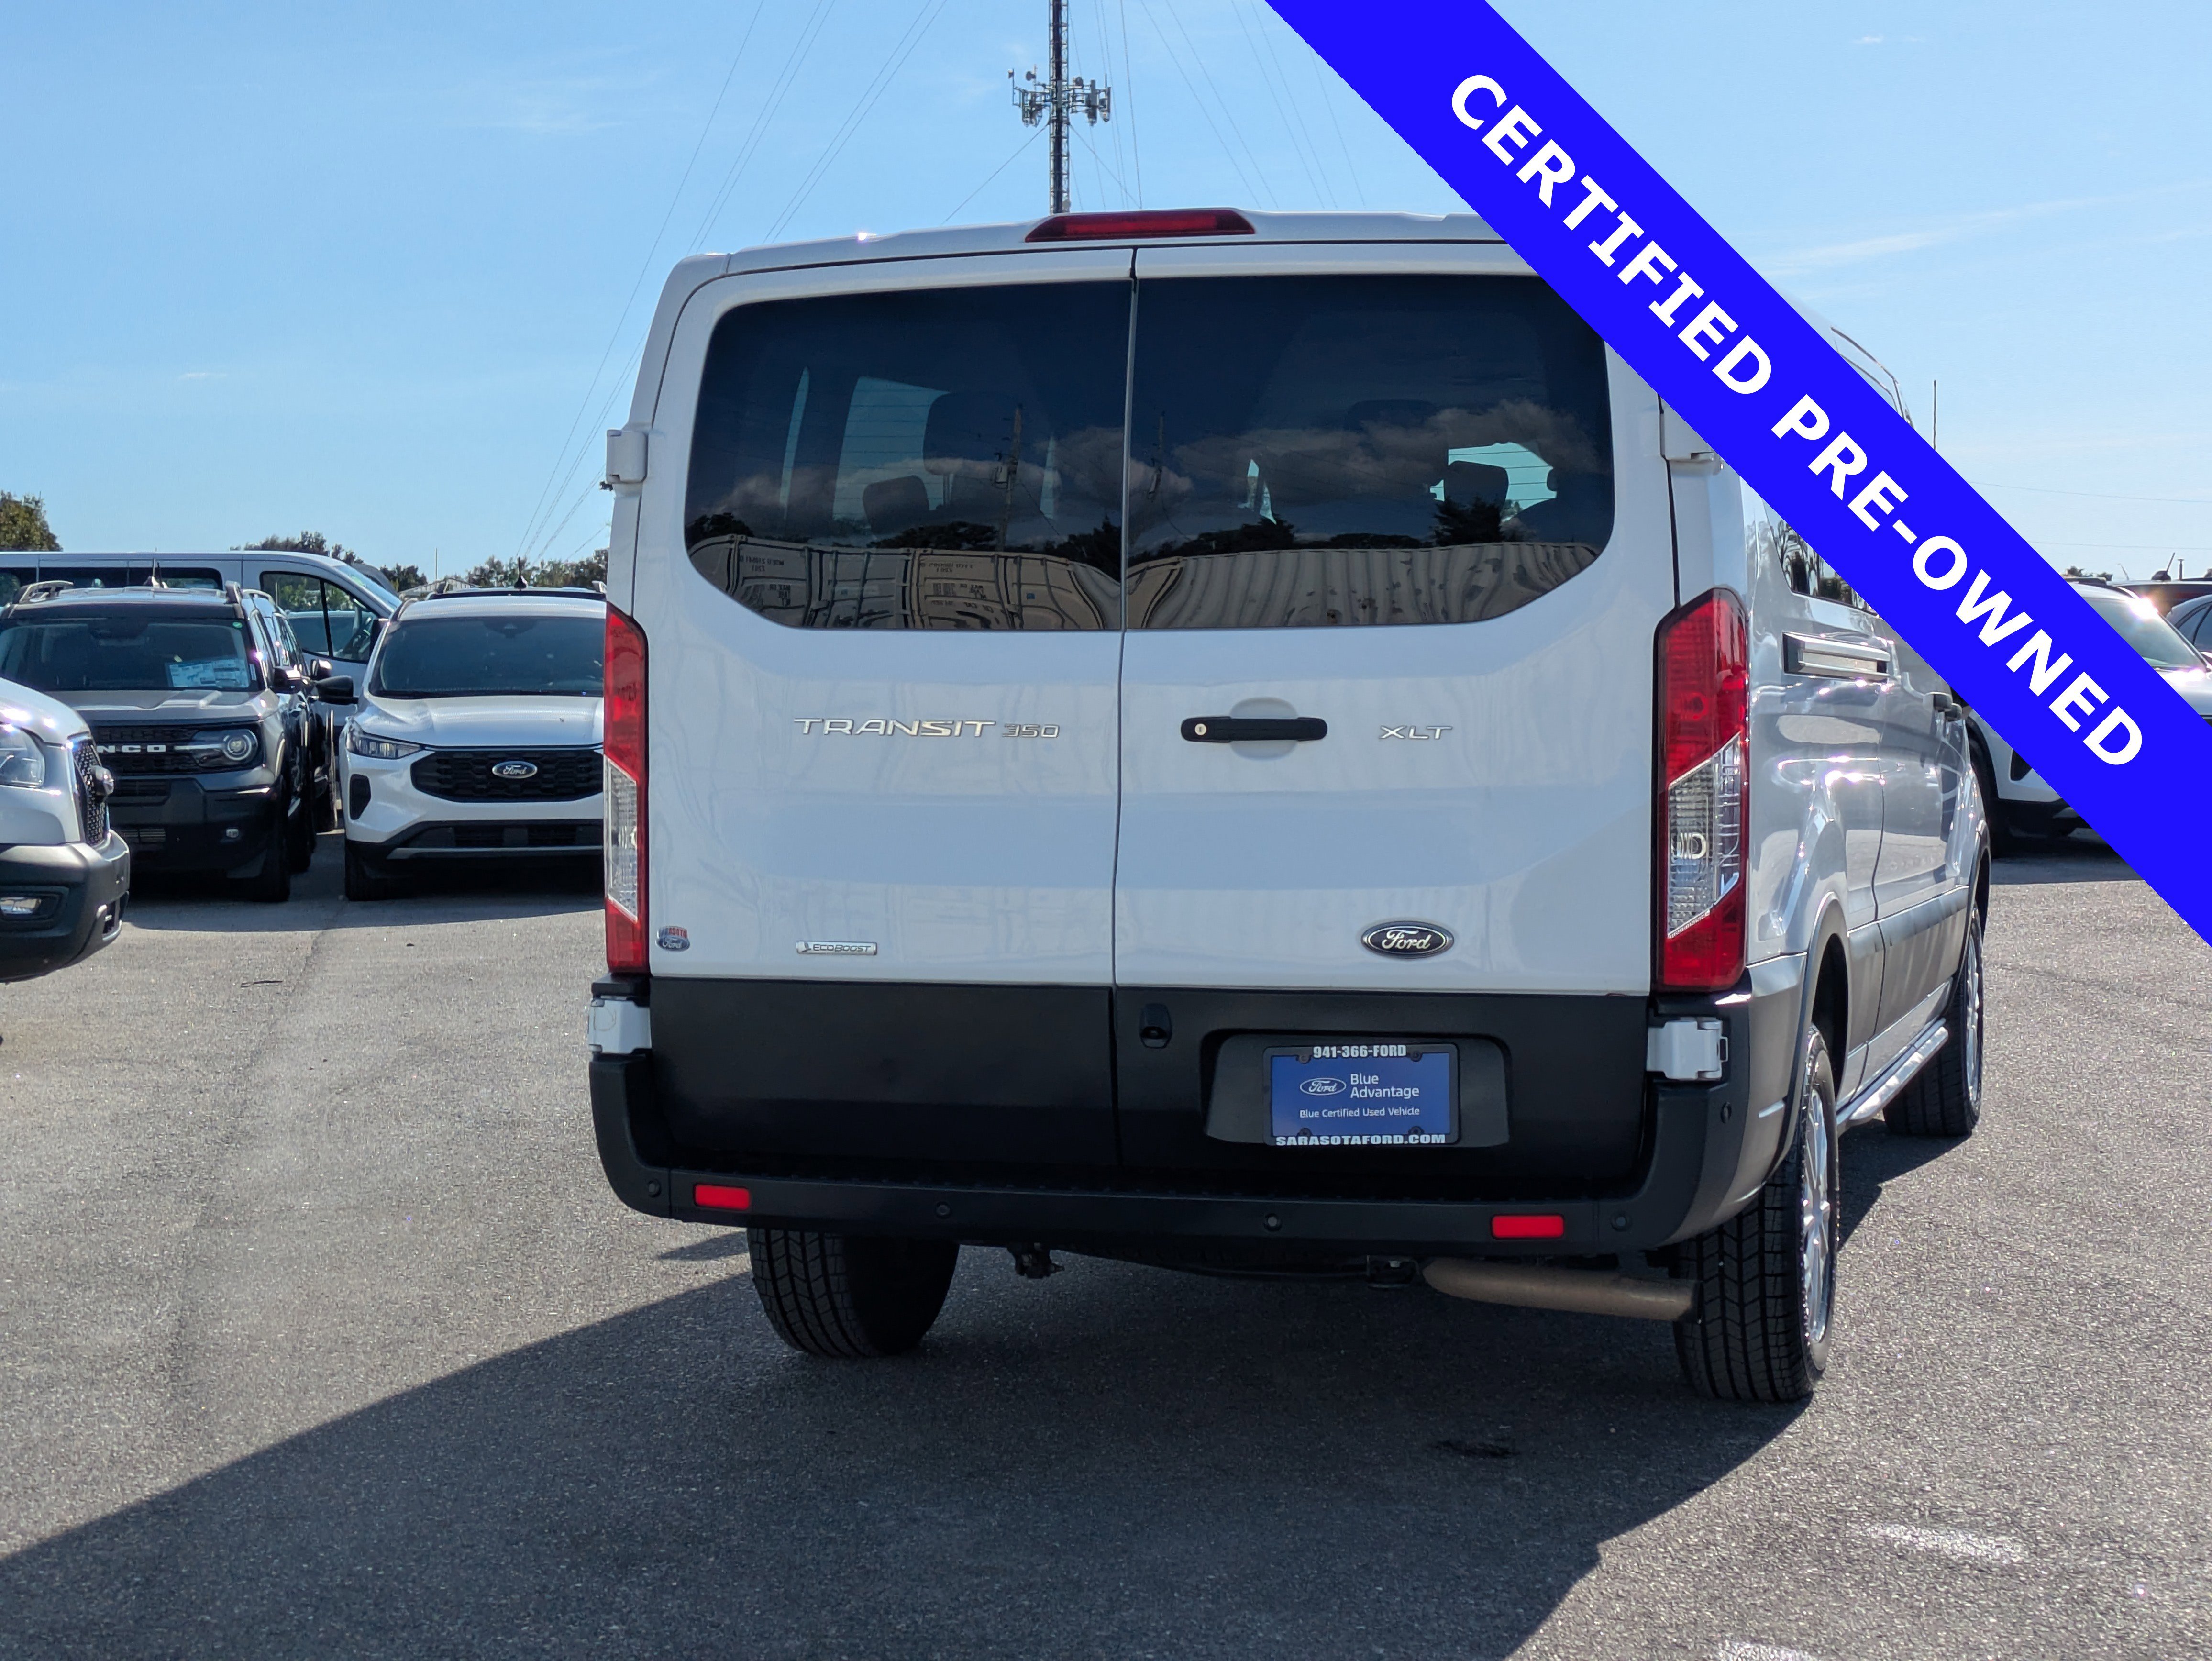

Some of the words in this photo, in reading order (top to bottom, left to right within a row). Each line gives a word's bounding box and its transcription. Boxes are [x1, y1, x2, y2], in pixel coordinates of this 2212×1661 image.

[794, 718, 995, 737] TRANSIT
[1003, 724, 1060, 738] 350
[1379, 725, 1452, 740] XLT
[96, 745, 166, 753] NCO
[503, 764, 527, 775] Ford
[1382, 929, 1432, 950] Ford
[1313, 1045, 1407, 1058] 941-366-FORD
[1350, 1073, 1379, 1085] Blue
[1308, 1080, 1338, 1093] Ford
[1350, 1086, 1420, 1099] Advantage
[1300, 1109, 1319, 1118] Blue
[1322, 1108, 1360, 1118] Certified
[1362, 1108, 1385, 1116] Used
[1388, 1107, 1420, 1116] Vehicle
[1276, 1134, 1446, 1146] SARASOTAFORD.COM
